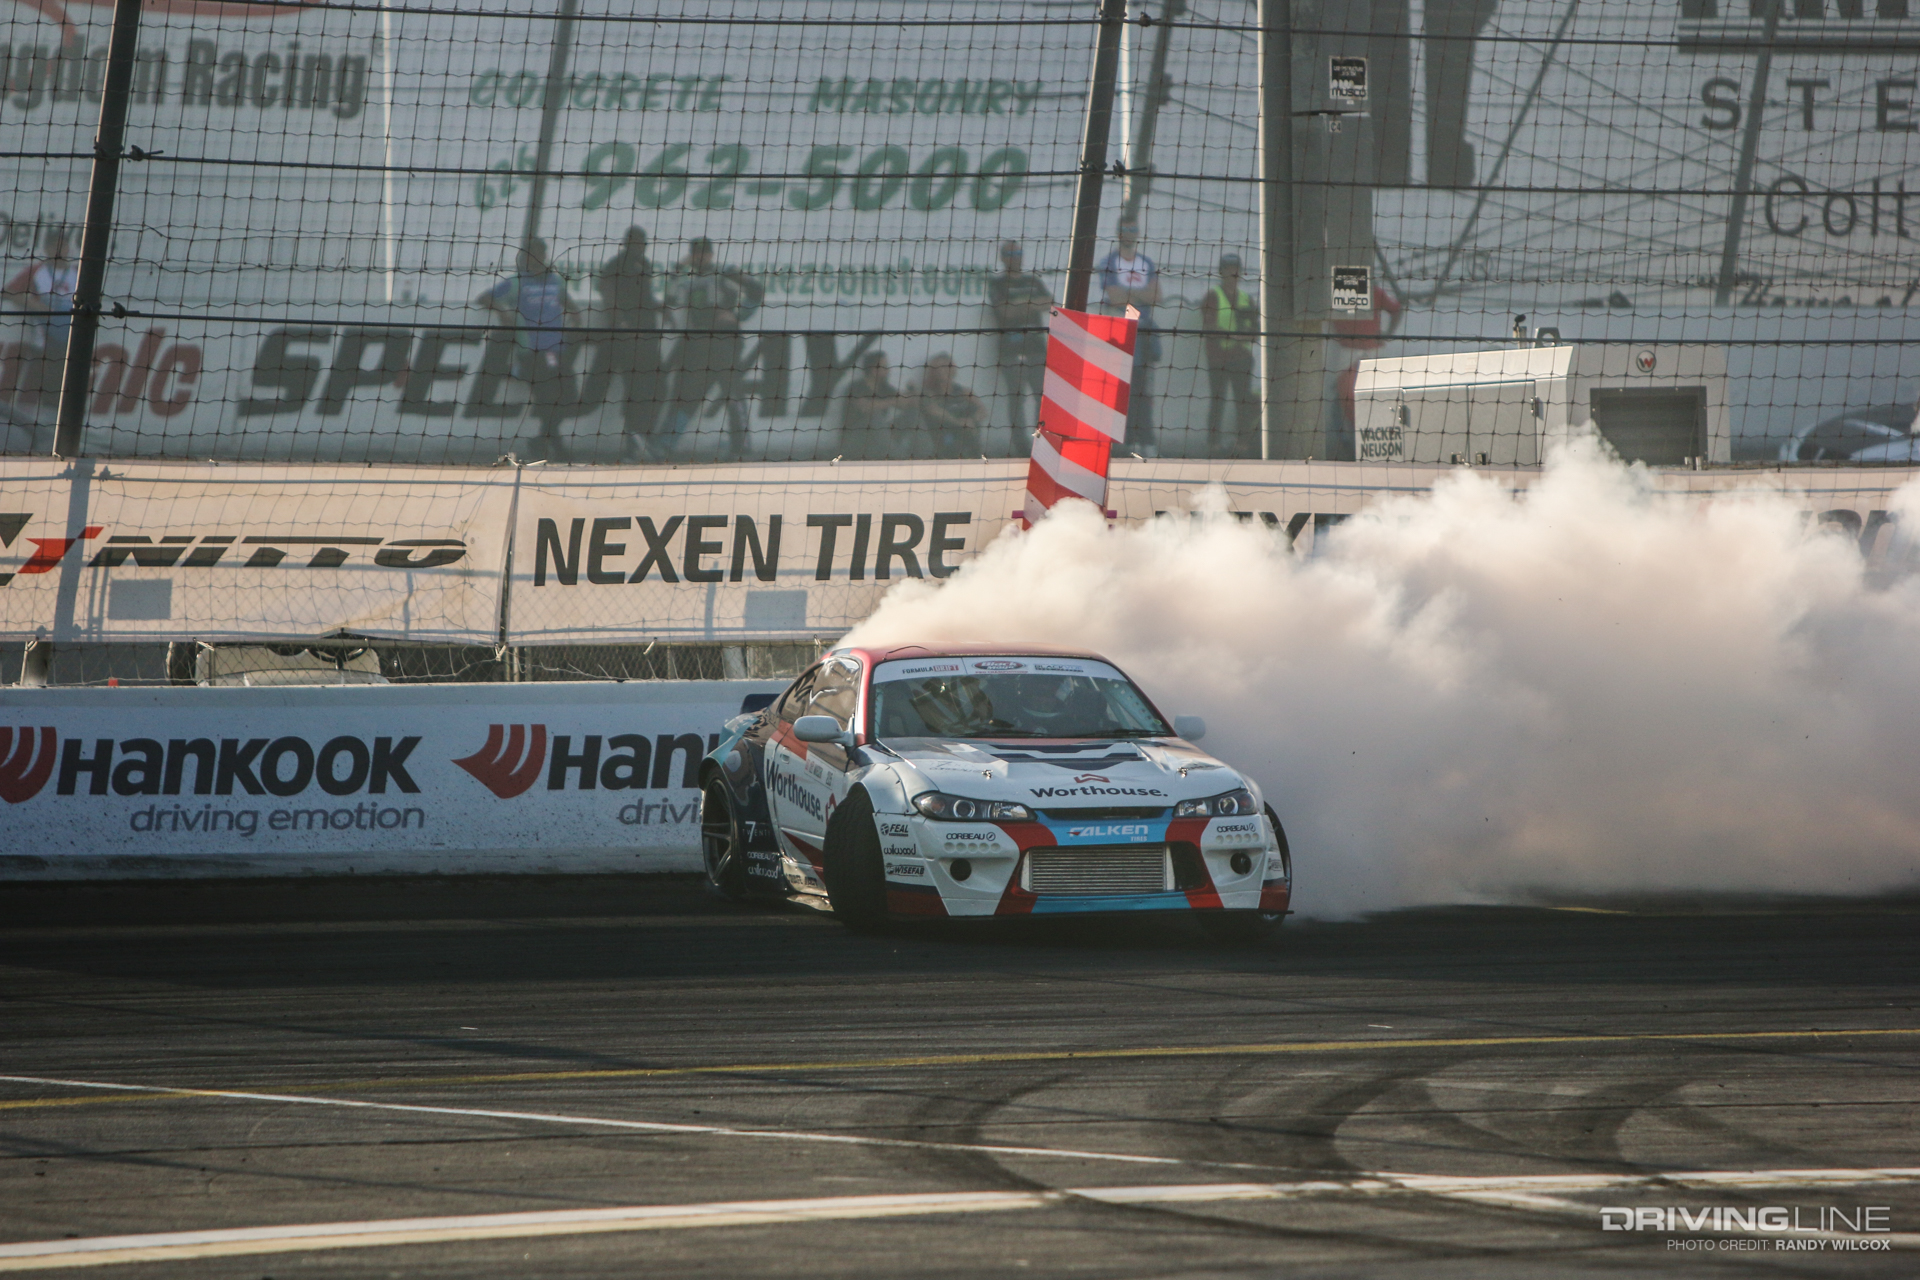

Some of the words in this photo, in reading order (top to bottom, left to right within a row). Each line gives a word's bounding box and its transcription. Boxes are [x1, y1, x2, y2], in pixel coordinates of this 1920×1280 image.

[183, 38, 366, 118] Racing
[471, 69, 728, 111] CONCRETE
[809, 76, 1040, 116] MASONRY
[579, 141, 1028, 212] 962-5000
[1360, 426, 1402, 441] WACKER
[1361, 442, 1402, 457] NEUSON
[87, 534, 467, 568] NITTO
[534, 514, 782, 586] NEXEN
[801, 512, 972, 581] TIRE
[1030, 786, 1169, 798] Worthouse.
[130, 804, 258, 837] driving
[268, 802, 424, 831] emotion
[890, 824, 909, 833] FEAL
[1068, 825, 1148, 837] FALKEN
[1216, 825, 1249, 833] CORBEAU
